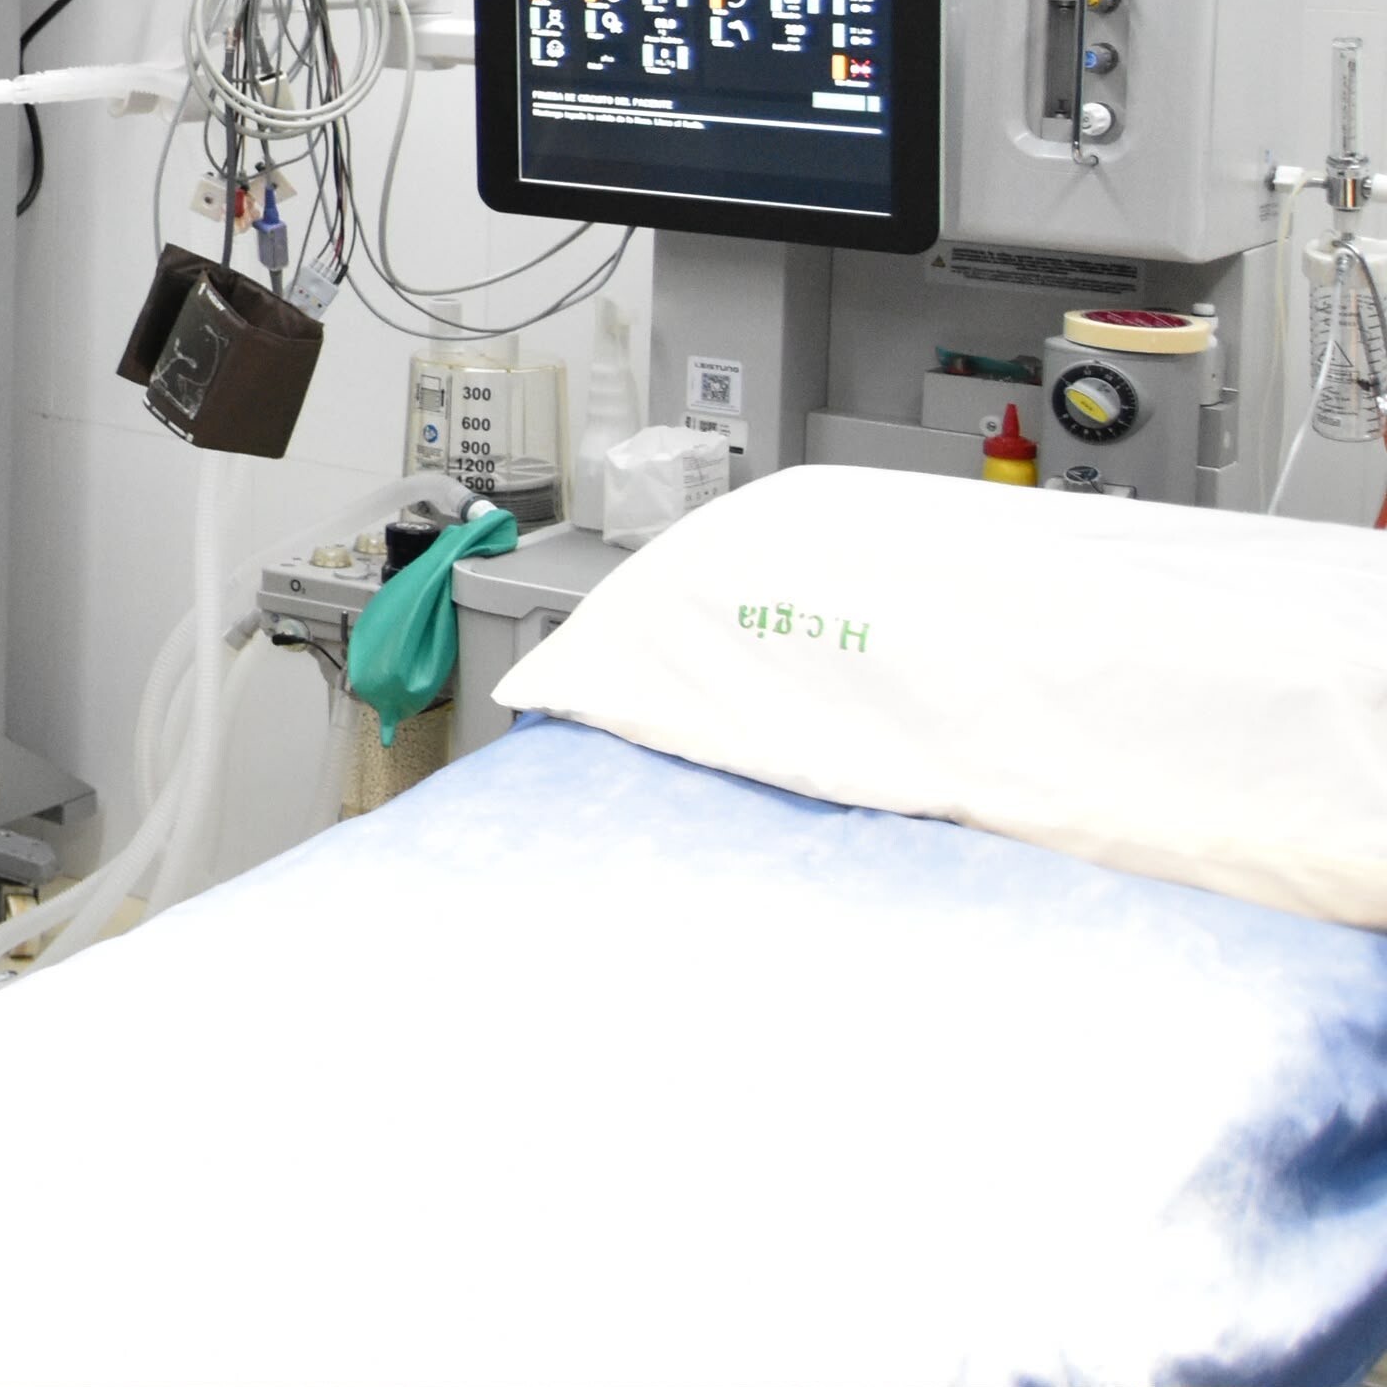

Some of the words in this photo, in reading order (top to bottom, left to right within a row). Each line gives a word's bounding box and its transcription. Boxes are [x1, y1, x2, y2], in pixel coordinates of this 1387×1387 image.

[462, 386, 492, 401] 300
[461, 416, 491, 431] 600
[460, 440, 491, 456] 900
[455, 458, 495, 474] 1200
